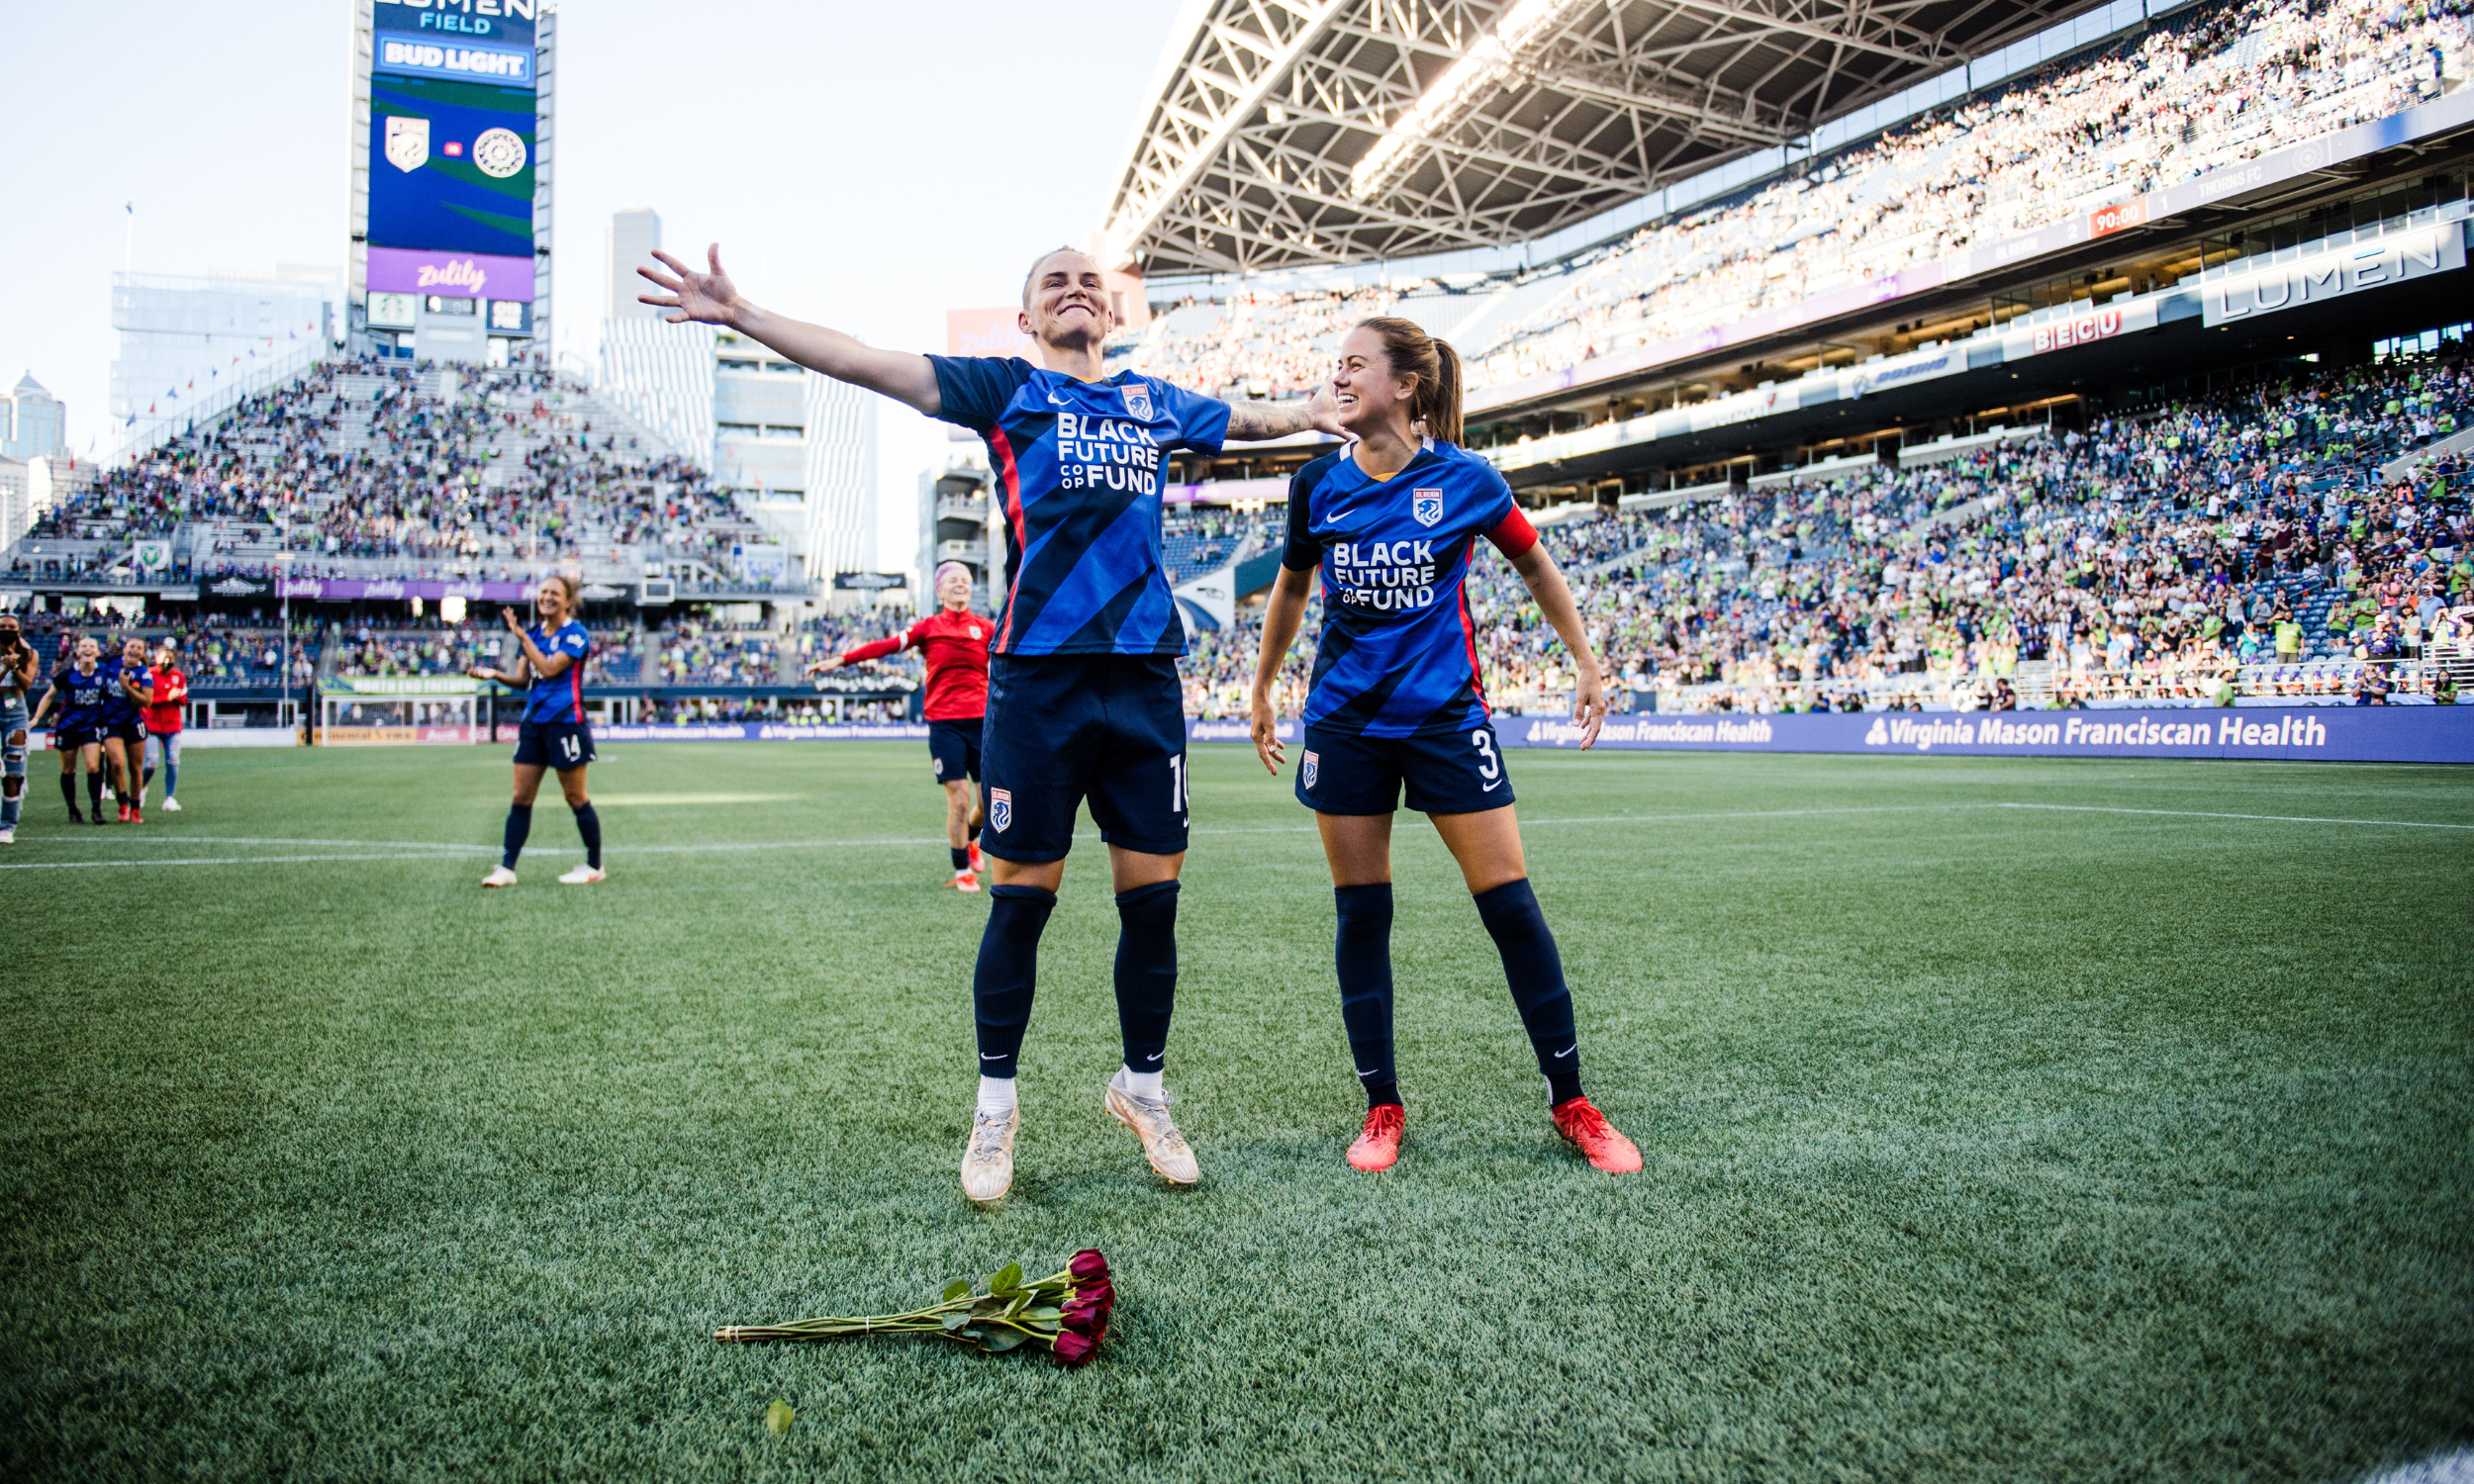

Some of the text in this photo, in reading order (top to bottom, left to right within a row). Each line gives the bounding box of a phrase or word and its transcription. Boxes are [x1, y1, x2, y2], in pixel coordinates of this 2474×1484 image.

[421, 12, 491, 35] FIELD
[385, 43, 524, 76] BUD LIGHT
[2198, 166, 2262, 198] THORNS FC
[2067, 223, 2078, 239] 2
[2097, 205, 2139, 232] 90:00
[2010, 237, 2039, 258] REIGN
[2221, 232, 2439, 319] LUMEN
[2035, 313, 2118, 350] BECU
[1875, 357, 1949, 383] BOEING
[1058, 412, 1159, 447] BLACK
[1058, 440, 1159, 470] FUTURE
[1060, 464, 1084, 476] CO
[1062, 465, 1157, 496] OP FUND
[1334, 540, 1435, 567] BLACK
[1335, 565, 1435, 587] FUTURE
[1343, 585, 1434, 610] OP FUND
[353, 679, 396, 693] NORTH
[398, 679, 422, 693] END
[1636, 720, 1714, 742] Franciscan
[1715, 719, 1772, 742] Health
[1890, 715, 2326, 750] Virginia Mason Franciscan Health
[560, 734, 581, 759] 14
[1473, 729, 1499, 780] 3
